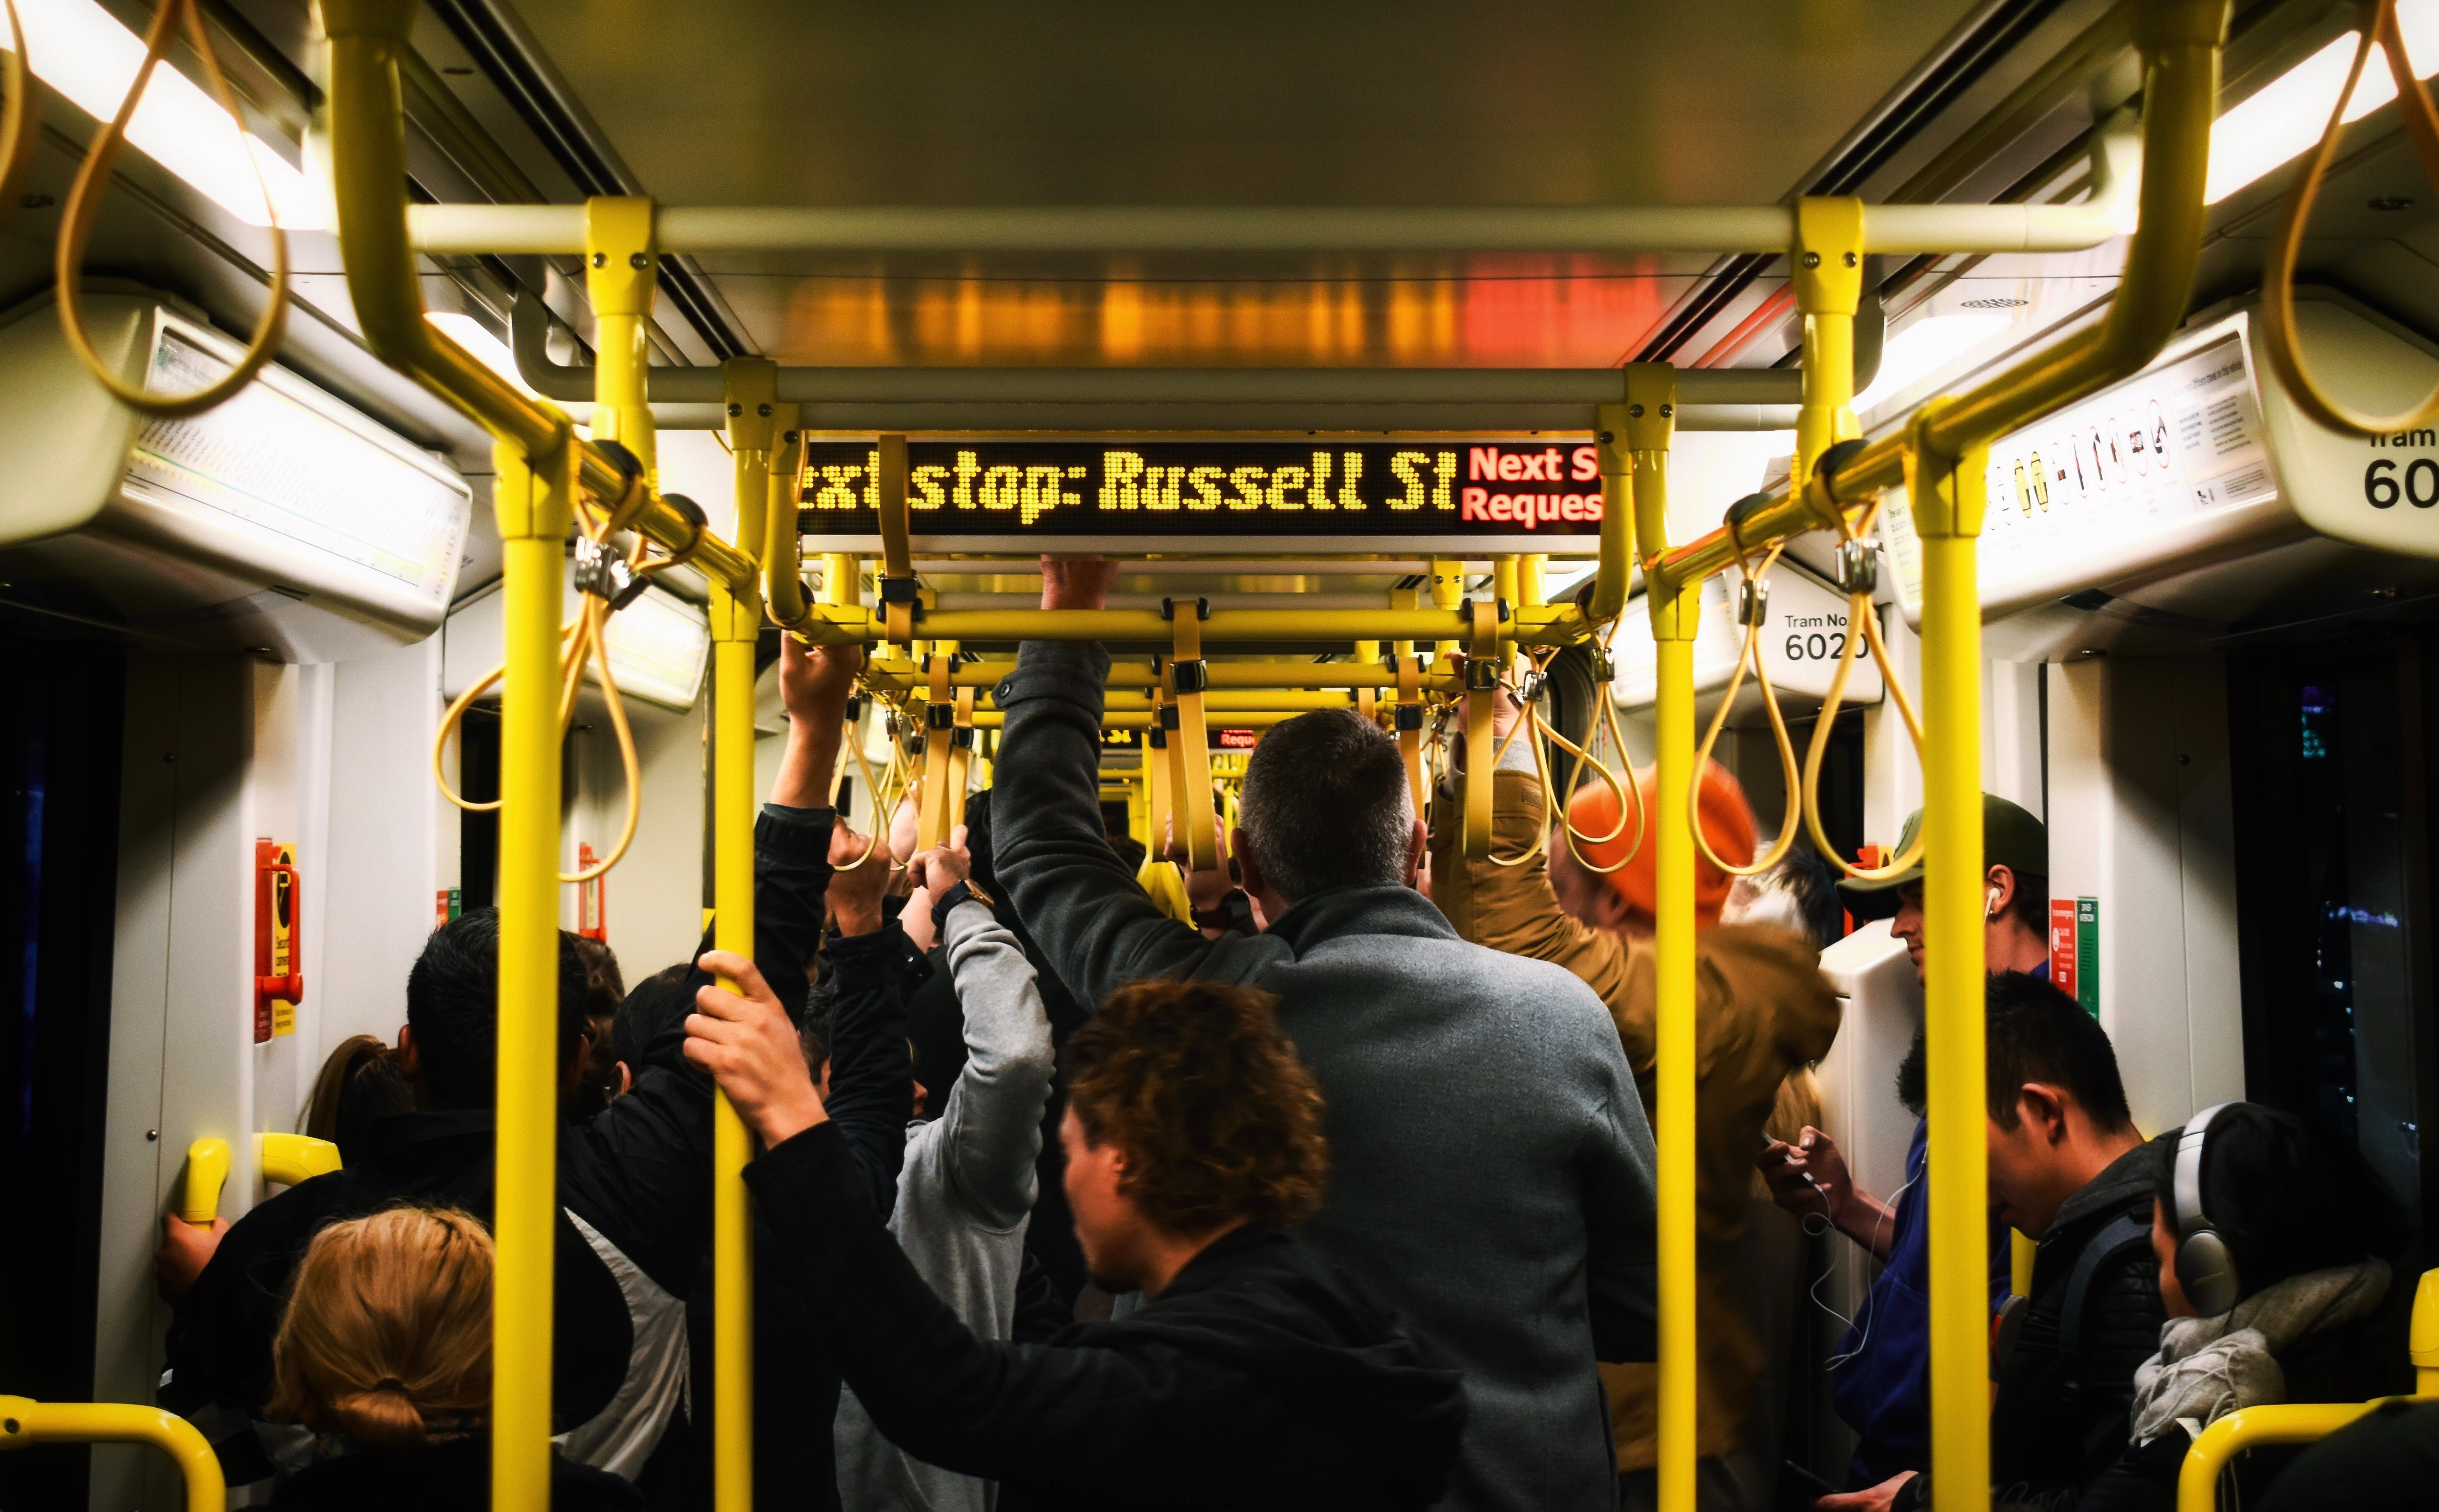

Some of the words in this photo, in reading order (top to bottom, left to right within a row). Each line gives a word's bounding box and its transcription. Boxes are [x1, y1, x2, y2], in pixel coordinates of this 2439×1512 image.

[1469, 447, 1563, 481] Next
[2364, 458, 2439, 510] 60
[907, 451, 1086, 525] stop:
[1099, 451, 1367, 510] Russell
[1385, 451, 1456, 510] St
[1785, 615, 1822, 627] Tram
